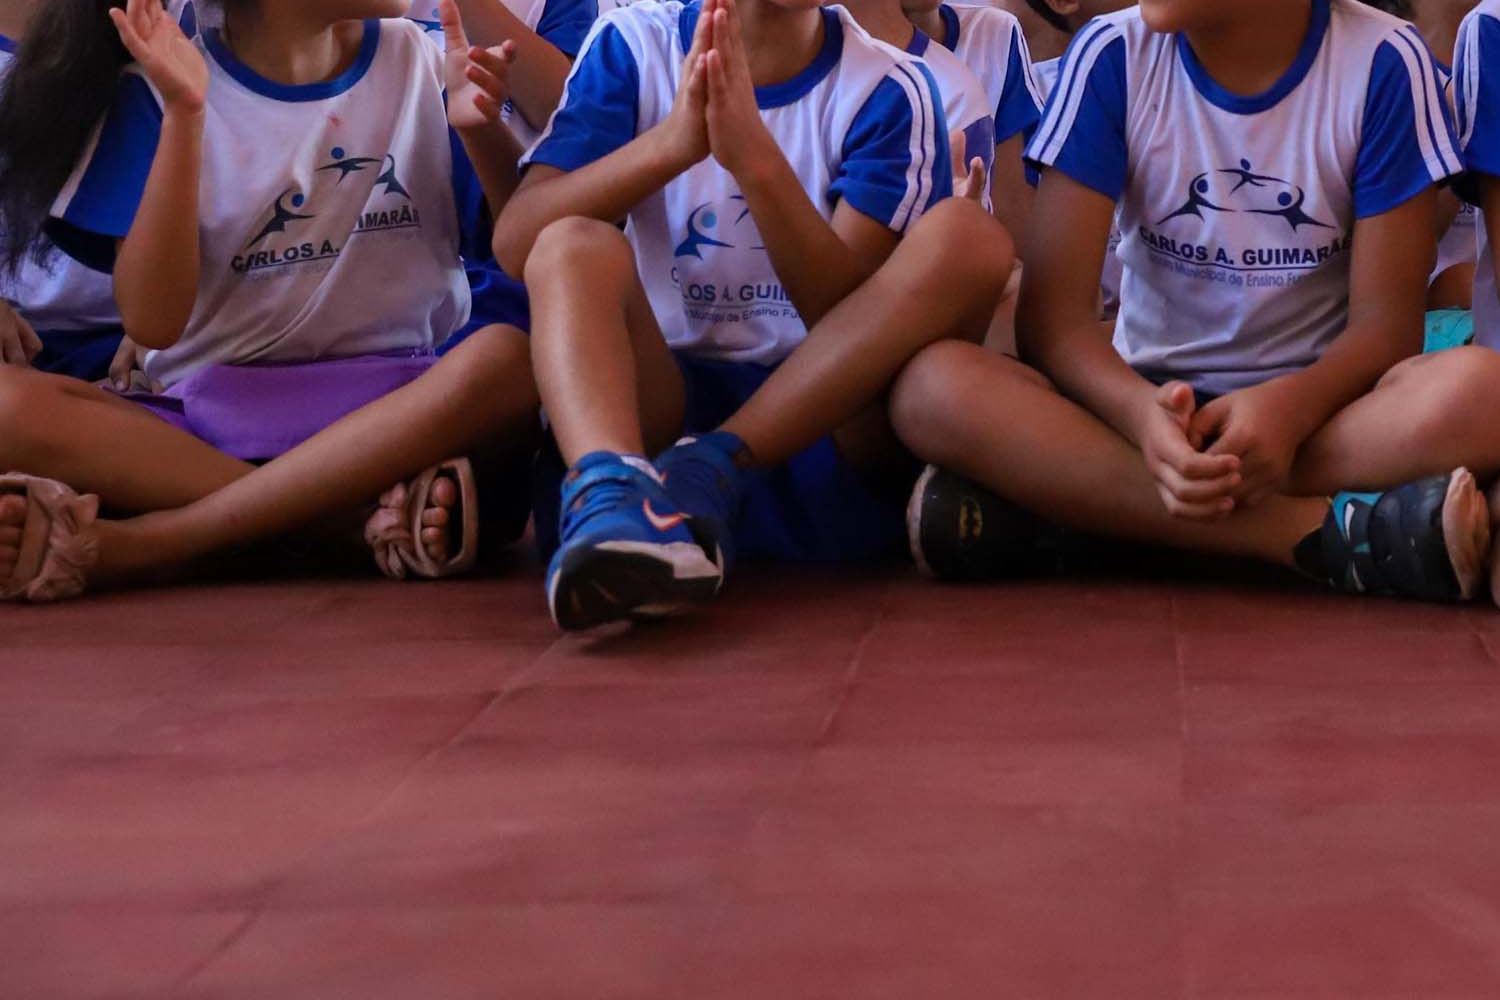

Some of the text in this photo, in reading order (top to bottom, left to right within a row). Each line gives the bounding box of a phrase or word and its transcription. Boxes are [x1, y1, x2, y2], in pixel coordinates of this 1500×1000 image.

[1139, 225, 1209, 262] CARLOS
[1215, 246, 1235, 266] A.
[1246, 273, 1284, 288] Ensino
